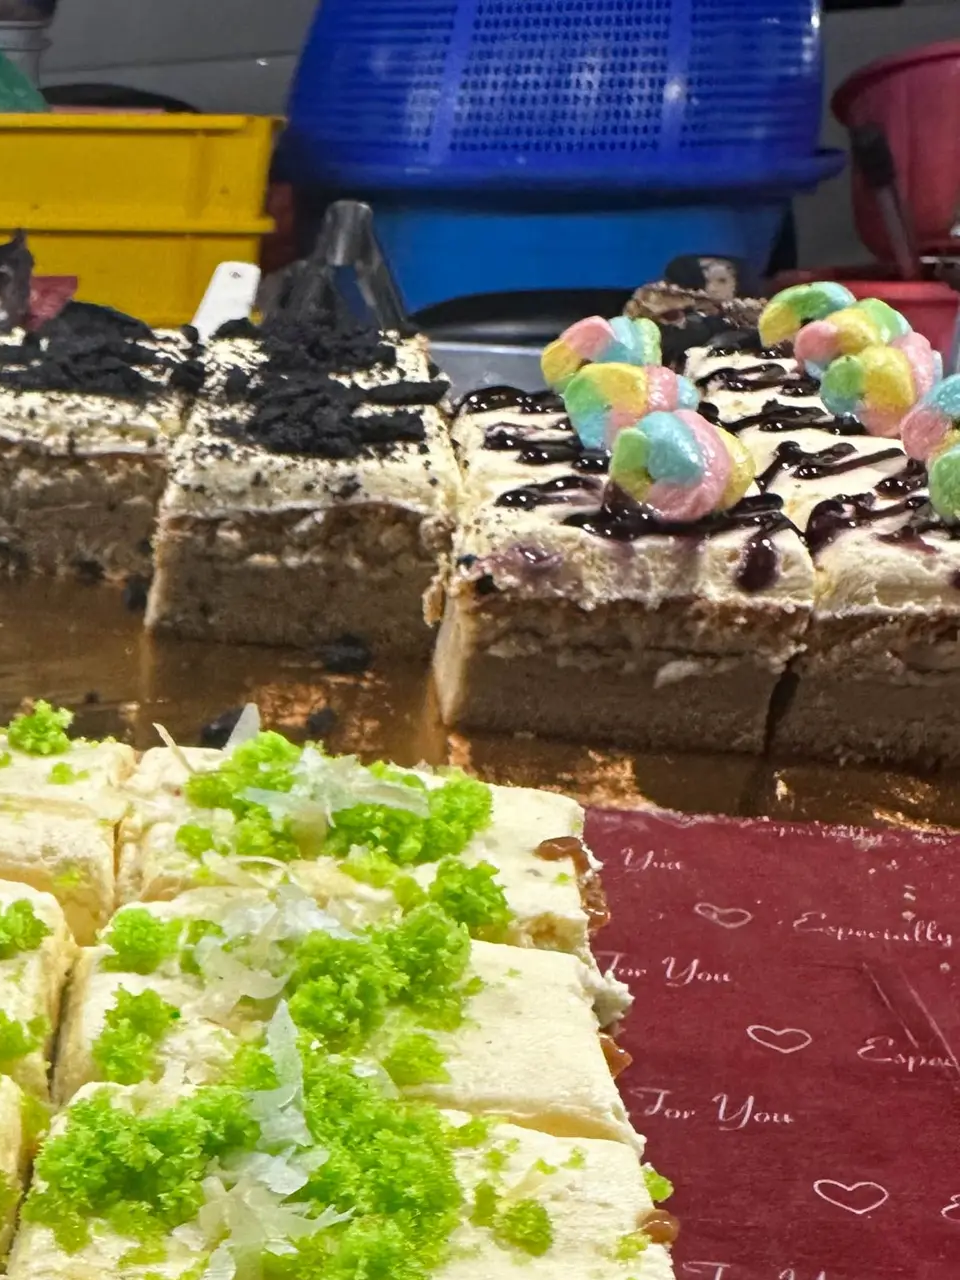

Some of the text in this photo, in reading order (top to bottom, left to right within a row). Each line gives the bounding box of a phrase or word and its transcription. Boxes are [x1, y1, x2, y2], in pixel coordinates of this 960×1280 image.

[661, 956, 731, 988] You
[857, 1035, 959, 1072] Espec
[629, 1087, 794, 1131] For You
